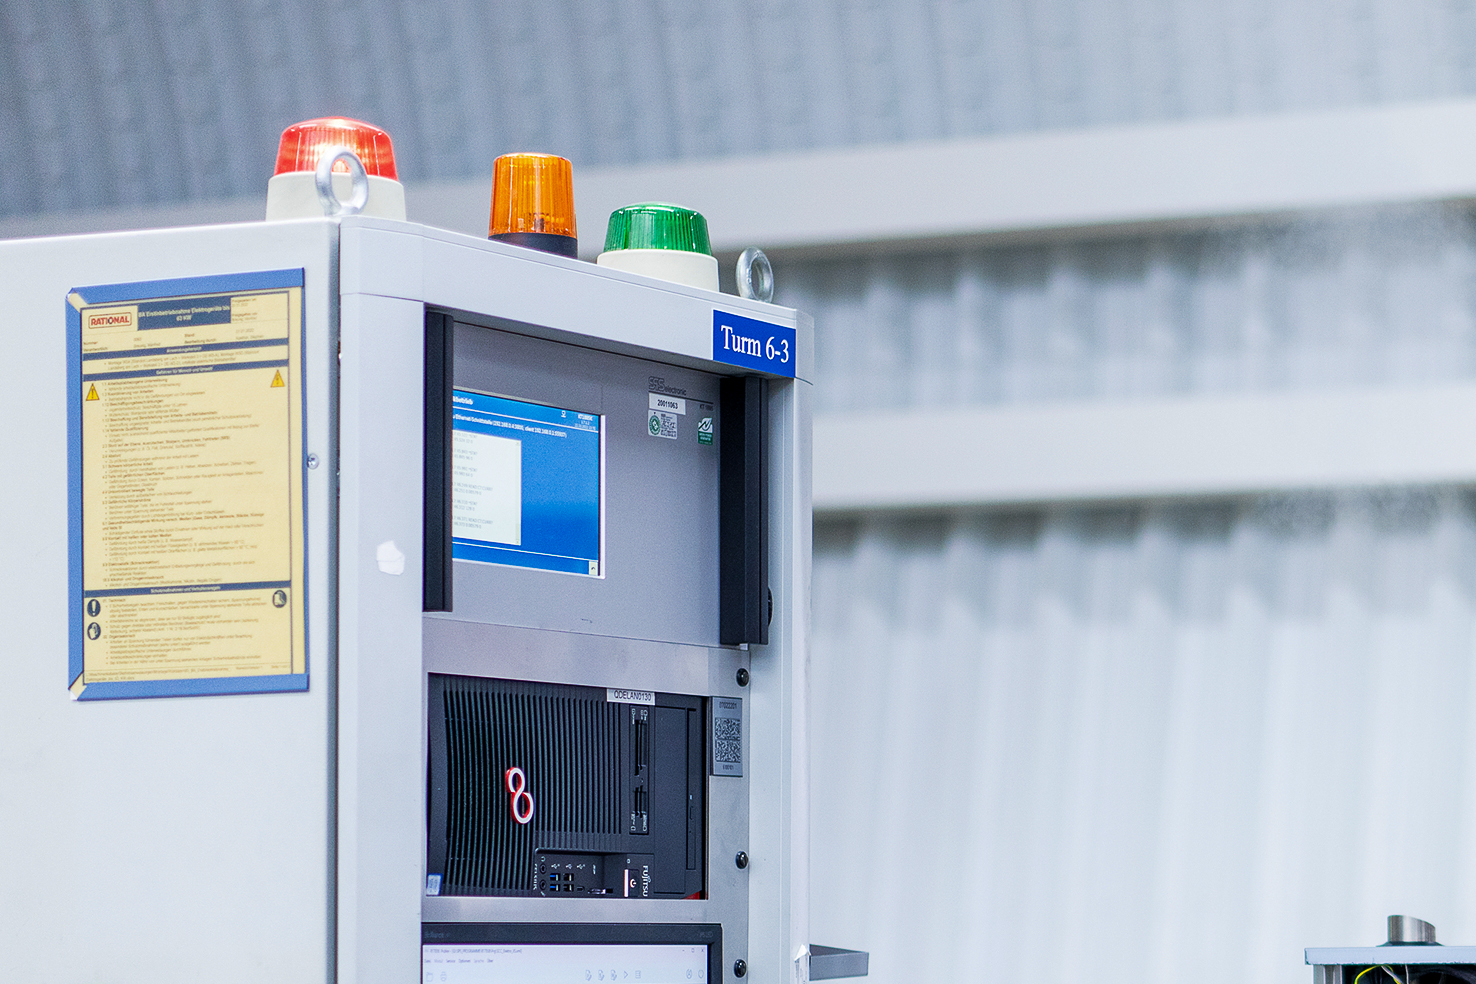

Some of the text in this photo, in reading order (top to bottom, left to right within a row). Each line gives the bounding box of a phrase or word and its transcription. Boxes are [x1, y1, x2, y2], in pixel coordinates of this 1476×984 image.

[90, 315, 130, 326] RATIONAL
[720, 324, 790, 363] Turm 6-3
[657, 399, 679, 410] 20011063
[641, 865, 652, 898] FUJITSU
